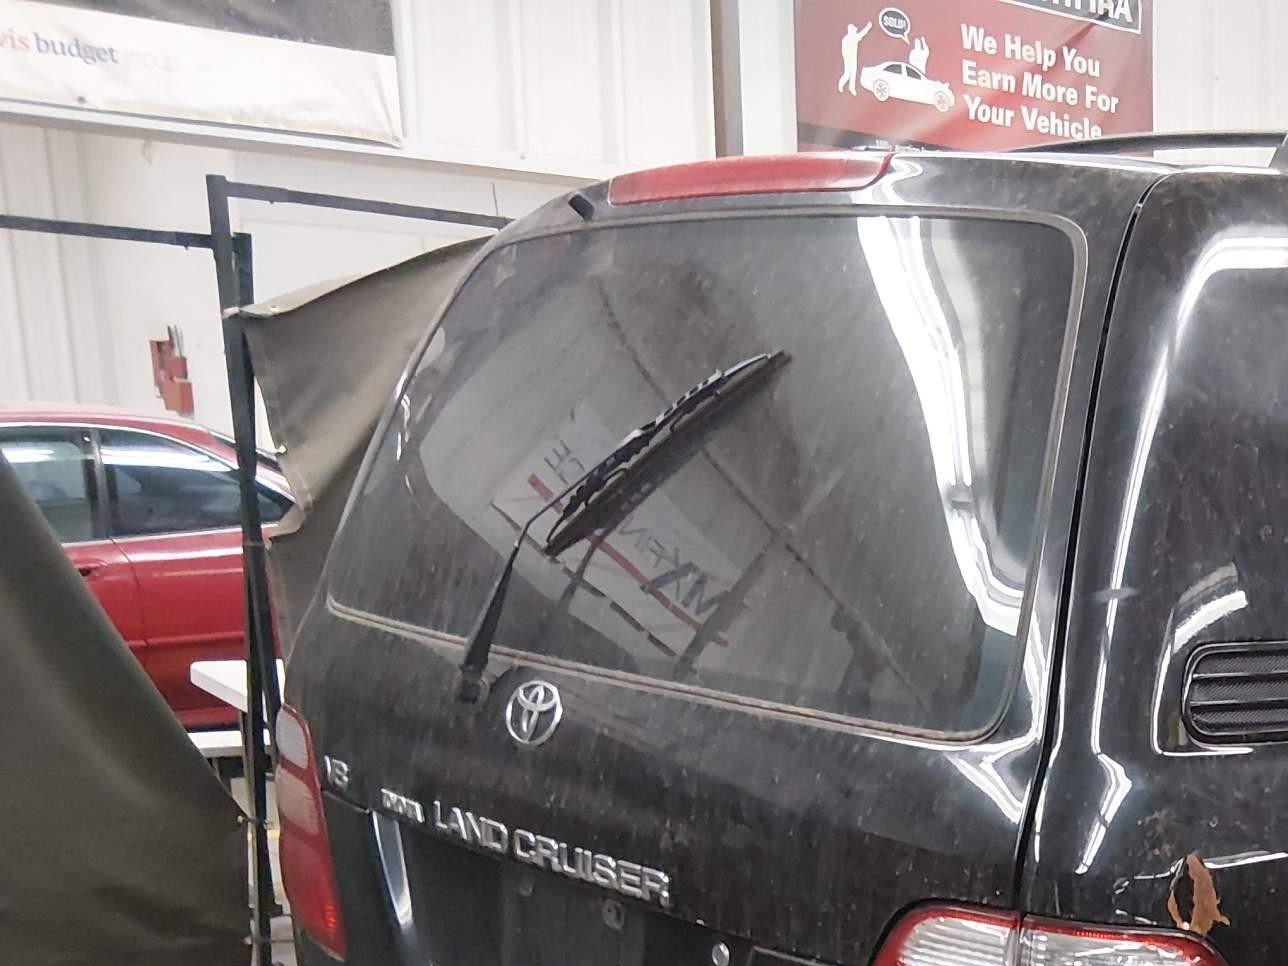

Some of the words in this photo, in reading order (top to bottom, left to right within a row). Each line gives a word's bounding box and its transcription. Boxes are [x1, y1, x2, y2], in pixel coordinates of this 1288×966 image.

[33, 31, 120, 65] budget
[961, 23, 997, 55] We
[1004, 33, 1056, 71] Help
[1062, 46, 1100, 77] You
[962, 59, 1016, 93] Earn
[1022, 71, 1078, 105] More
[1085, 84, 1119, 114] For
[962, 94, 1014, 128] Your
[1021, 105, 1102, 141] Vehicle
[433, 800, 508, 856] LAND
[513, 828, 670, 908] CRUISER
